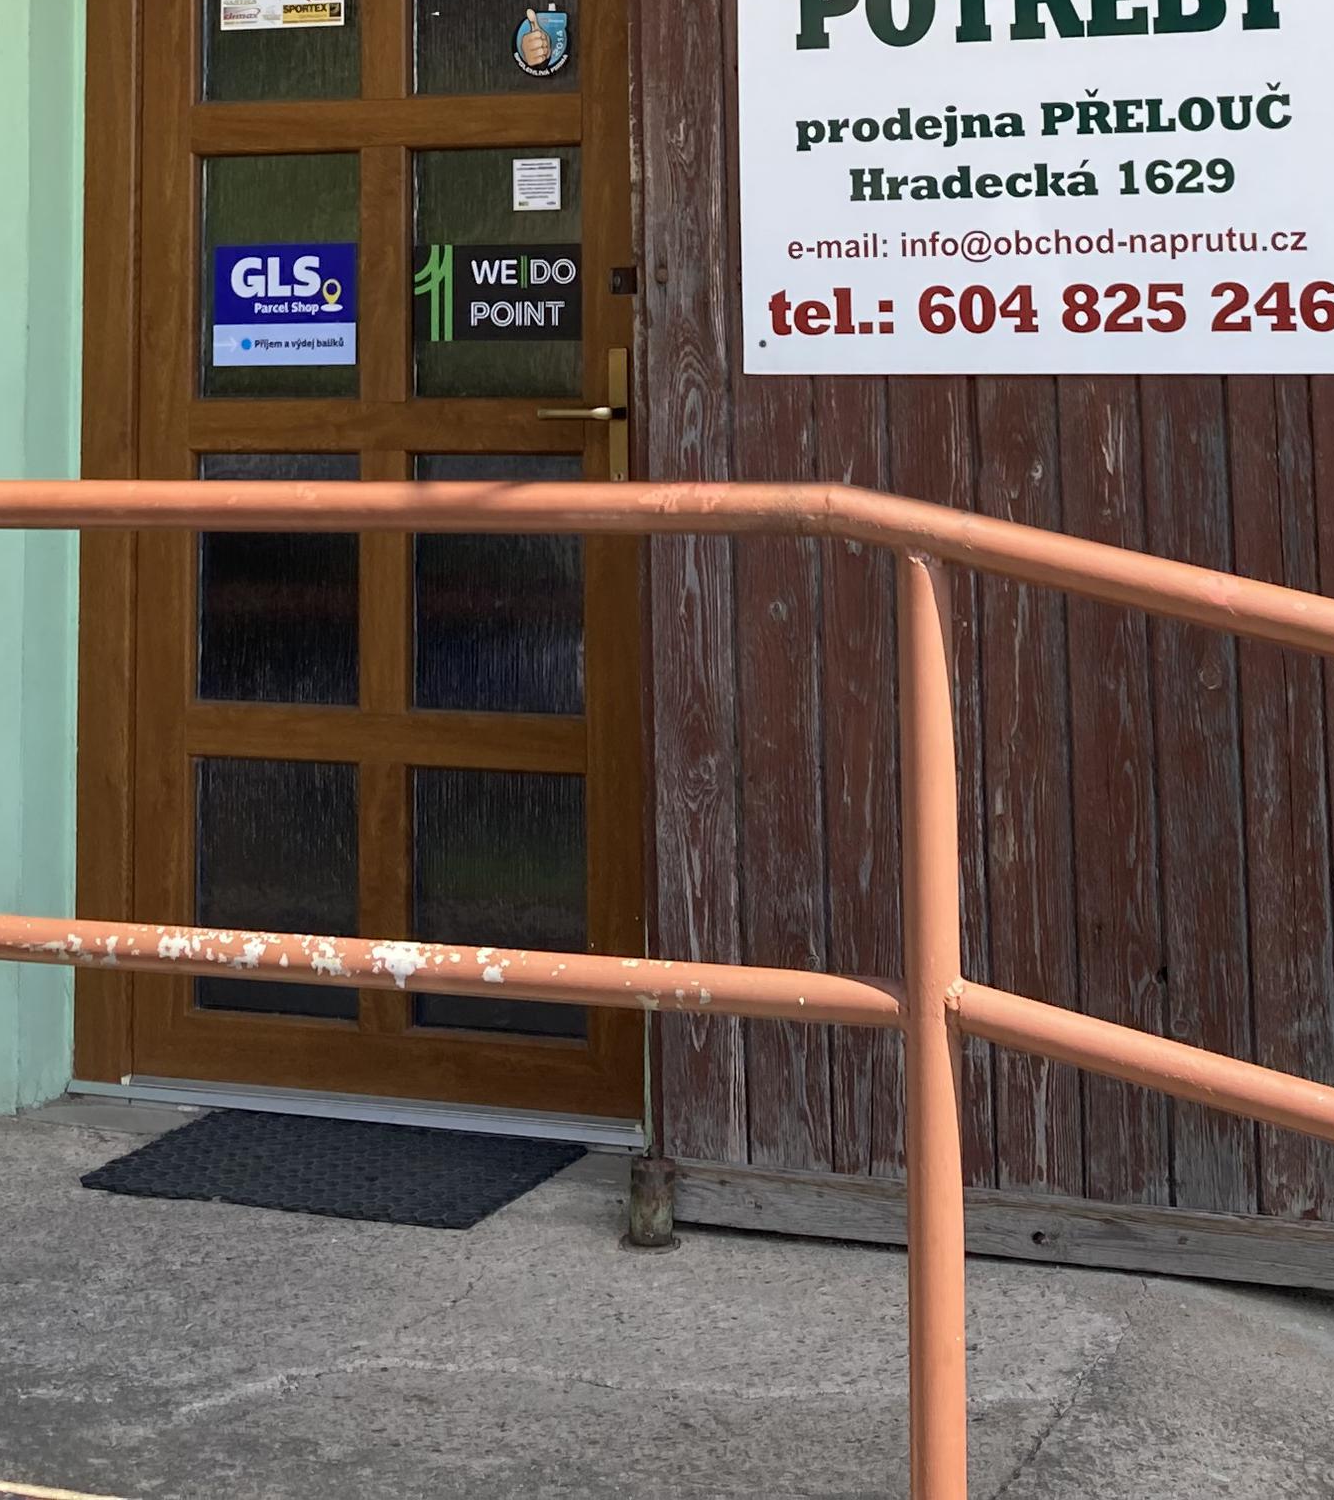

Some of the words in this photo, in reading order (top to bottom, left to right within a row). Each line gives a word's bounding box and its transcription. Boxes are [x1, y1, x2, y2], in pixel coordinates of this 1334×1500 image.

[283, 3, 328, 14] SPORTEX
[795, 104, 1026, 151] prodejna
[1040, 82, 1293, 136] PŘELOUČ
[848, 159, 1099, 202] Hradecká
[1119, 158, 1235, 196] 1629
[787, 233, 889, 260] e-mail:
[900, 225, 1308, 263] info@obchod-naprutu.cz
[254, 302, 289, 314] Parcel
[290, 302, 319, 316] Shop
[470, 301, 565, 327] POINT
[768, 287, 895, 337] tel.:
[918, 283, 1039, 336] 604
[1061, 282, 1188, 335] 825
[284, 340, 290, 348] a
[291, 338, 315, 350] výdej
